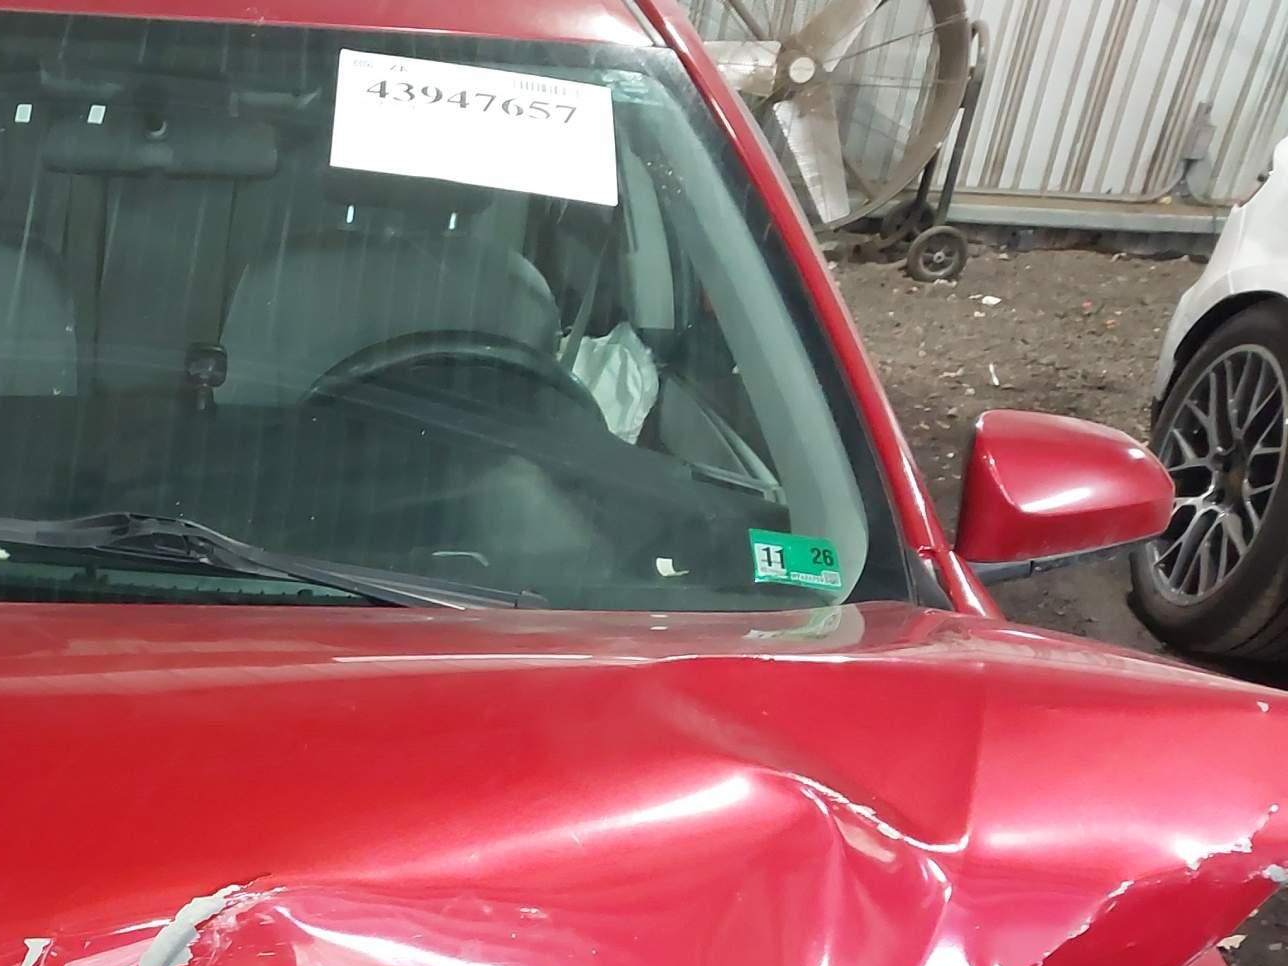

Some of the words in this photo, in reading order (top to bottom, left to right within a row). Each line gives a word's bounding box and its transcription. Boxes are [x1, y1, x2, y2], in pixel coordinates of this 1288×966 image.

[366, 80, 578, 125] 43947657
[761, 546, 785, 569] 11
[811, 547, 834, 567] 26
